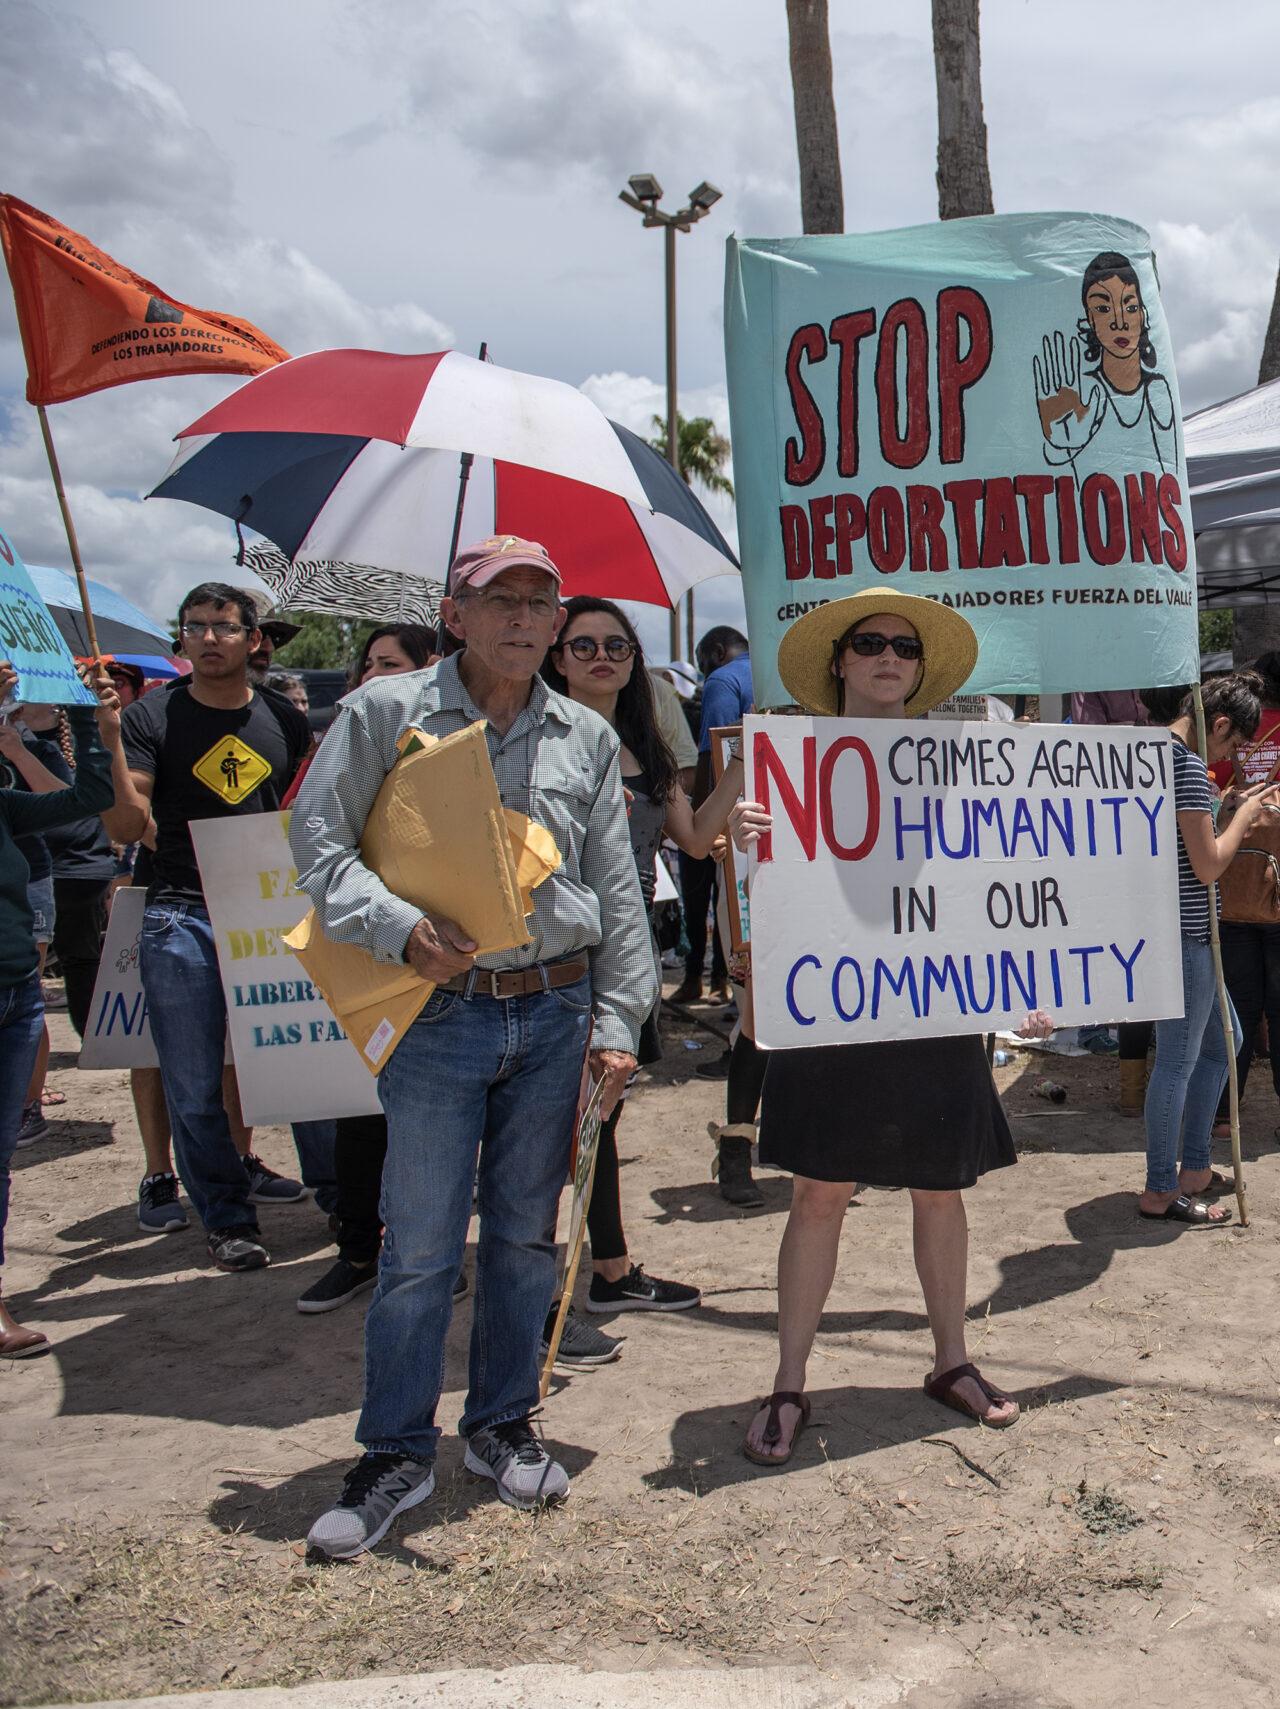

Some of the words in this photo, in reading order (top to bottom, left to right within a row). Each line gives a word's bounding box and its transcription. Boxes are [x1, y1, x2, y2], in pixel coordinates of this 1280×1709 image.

[91, 328, 150, 355] DEFENDIENDO
[153, 327, 176, 339] LOS
[180, 328, 247, 348] DERECHOS
[113, 346, 133, 361] LOS
[135, 341, 224, 357] TRABAJADORES
[784, 285, 993, 486] STOP
[779, 471, 1188, 581] DEPORTATIONS
[1052, 588, 1130, 606] FUERZA
[1134, 588, 1163, 605] DEL
[1165, 588, 1192, 606] VALLE
[952, 695, 981, 705] FAMILIES
[753, 731, 880, 863] NO
[889, 736, 1015, 787] CRIMES
[1027, 739, 1168, 790] AGAINST
[893, 796, 1165, 860] HUMANITY
[892, 885, 936, 934] IN
[986, 877, 1068, 929] OUR
[785, 939, 1146, 1026] COMMUNITY
[253, 1022, 302, 1048] LAS
